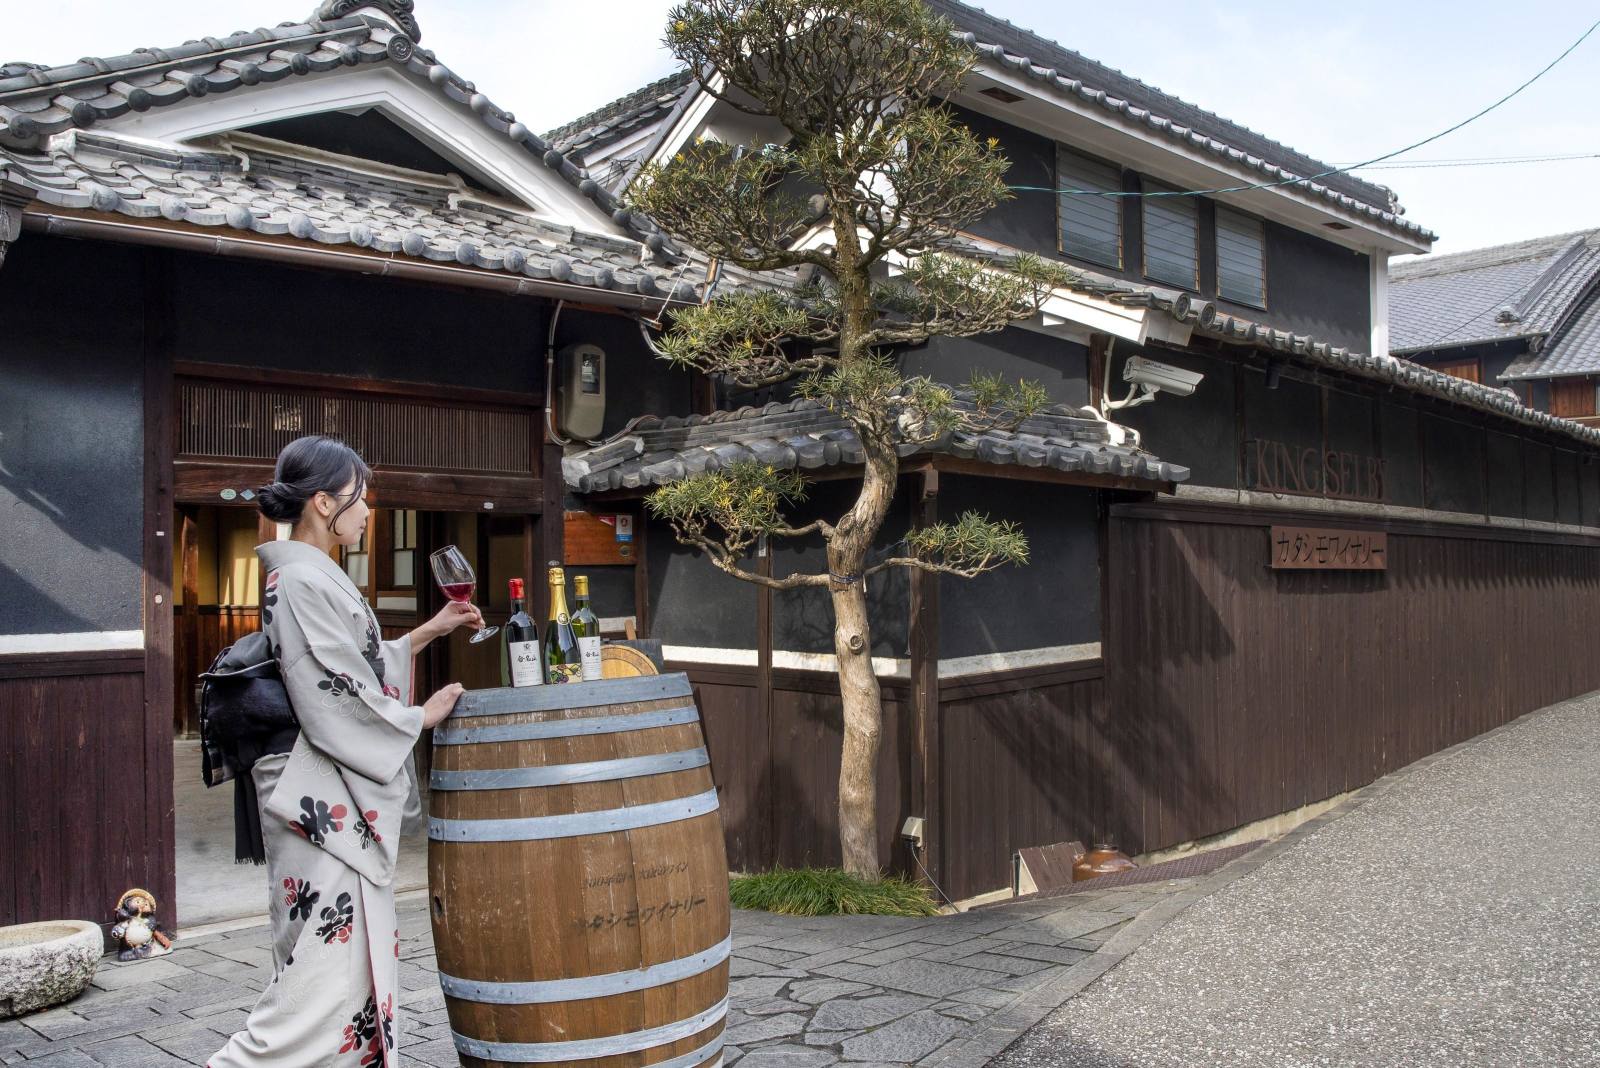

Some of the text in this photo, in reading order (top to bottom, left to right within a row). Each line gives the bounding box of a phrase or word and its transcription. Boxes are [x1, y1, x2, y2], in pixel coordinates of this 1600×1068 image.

[1256, 439, 1319, 492] KING
[1277, 531, 1384, 564] カタシモワイナリー
[572, 896, 706, 931] タシモワイナリー
